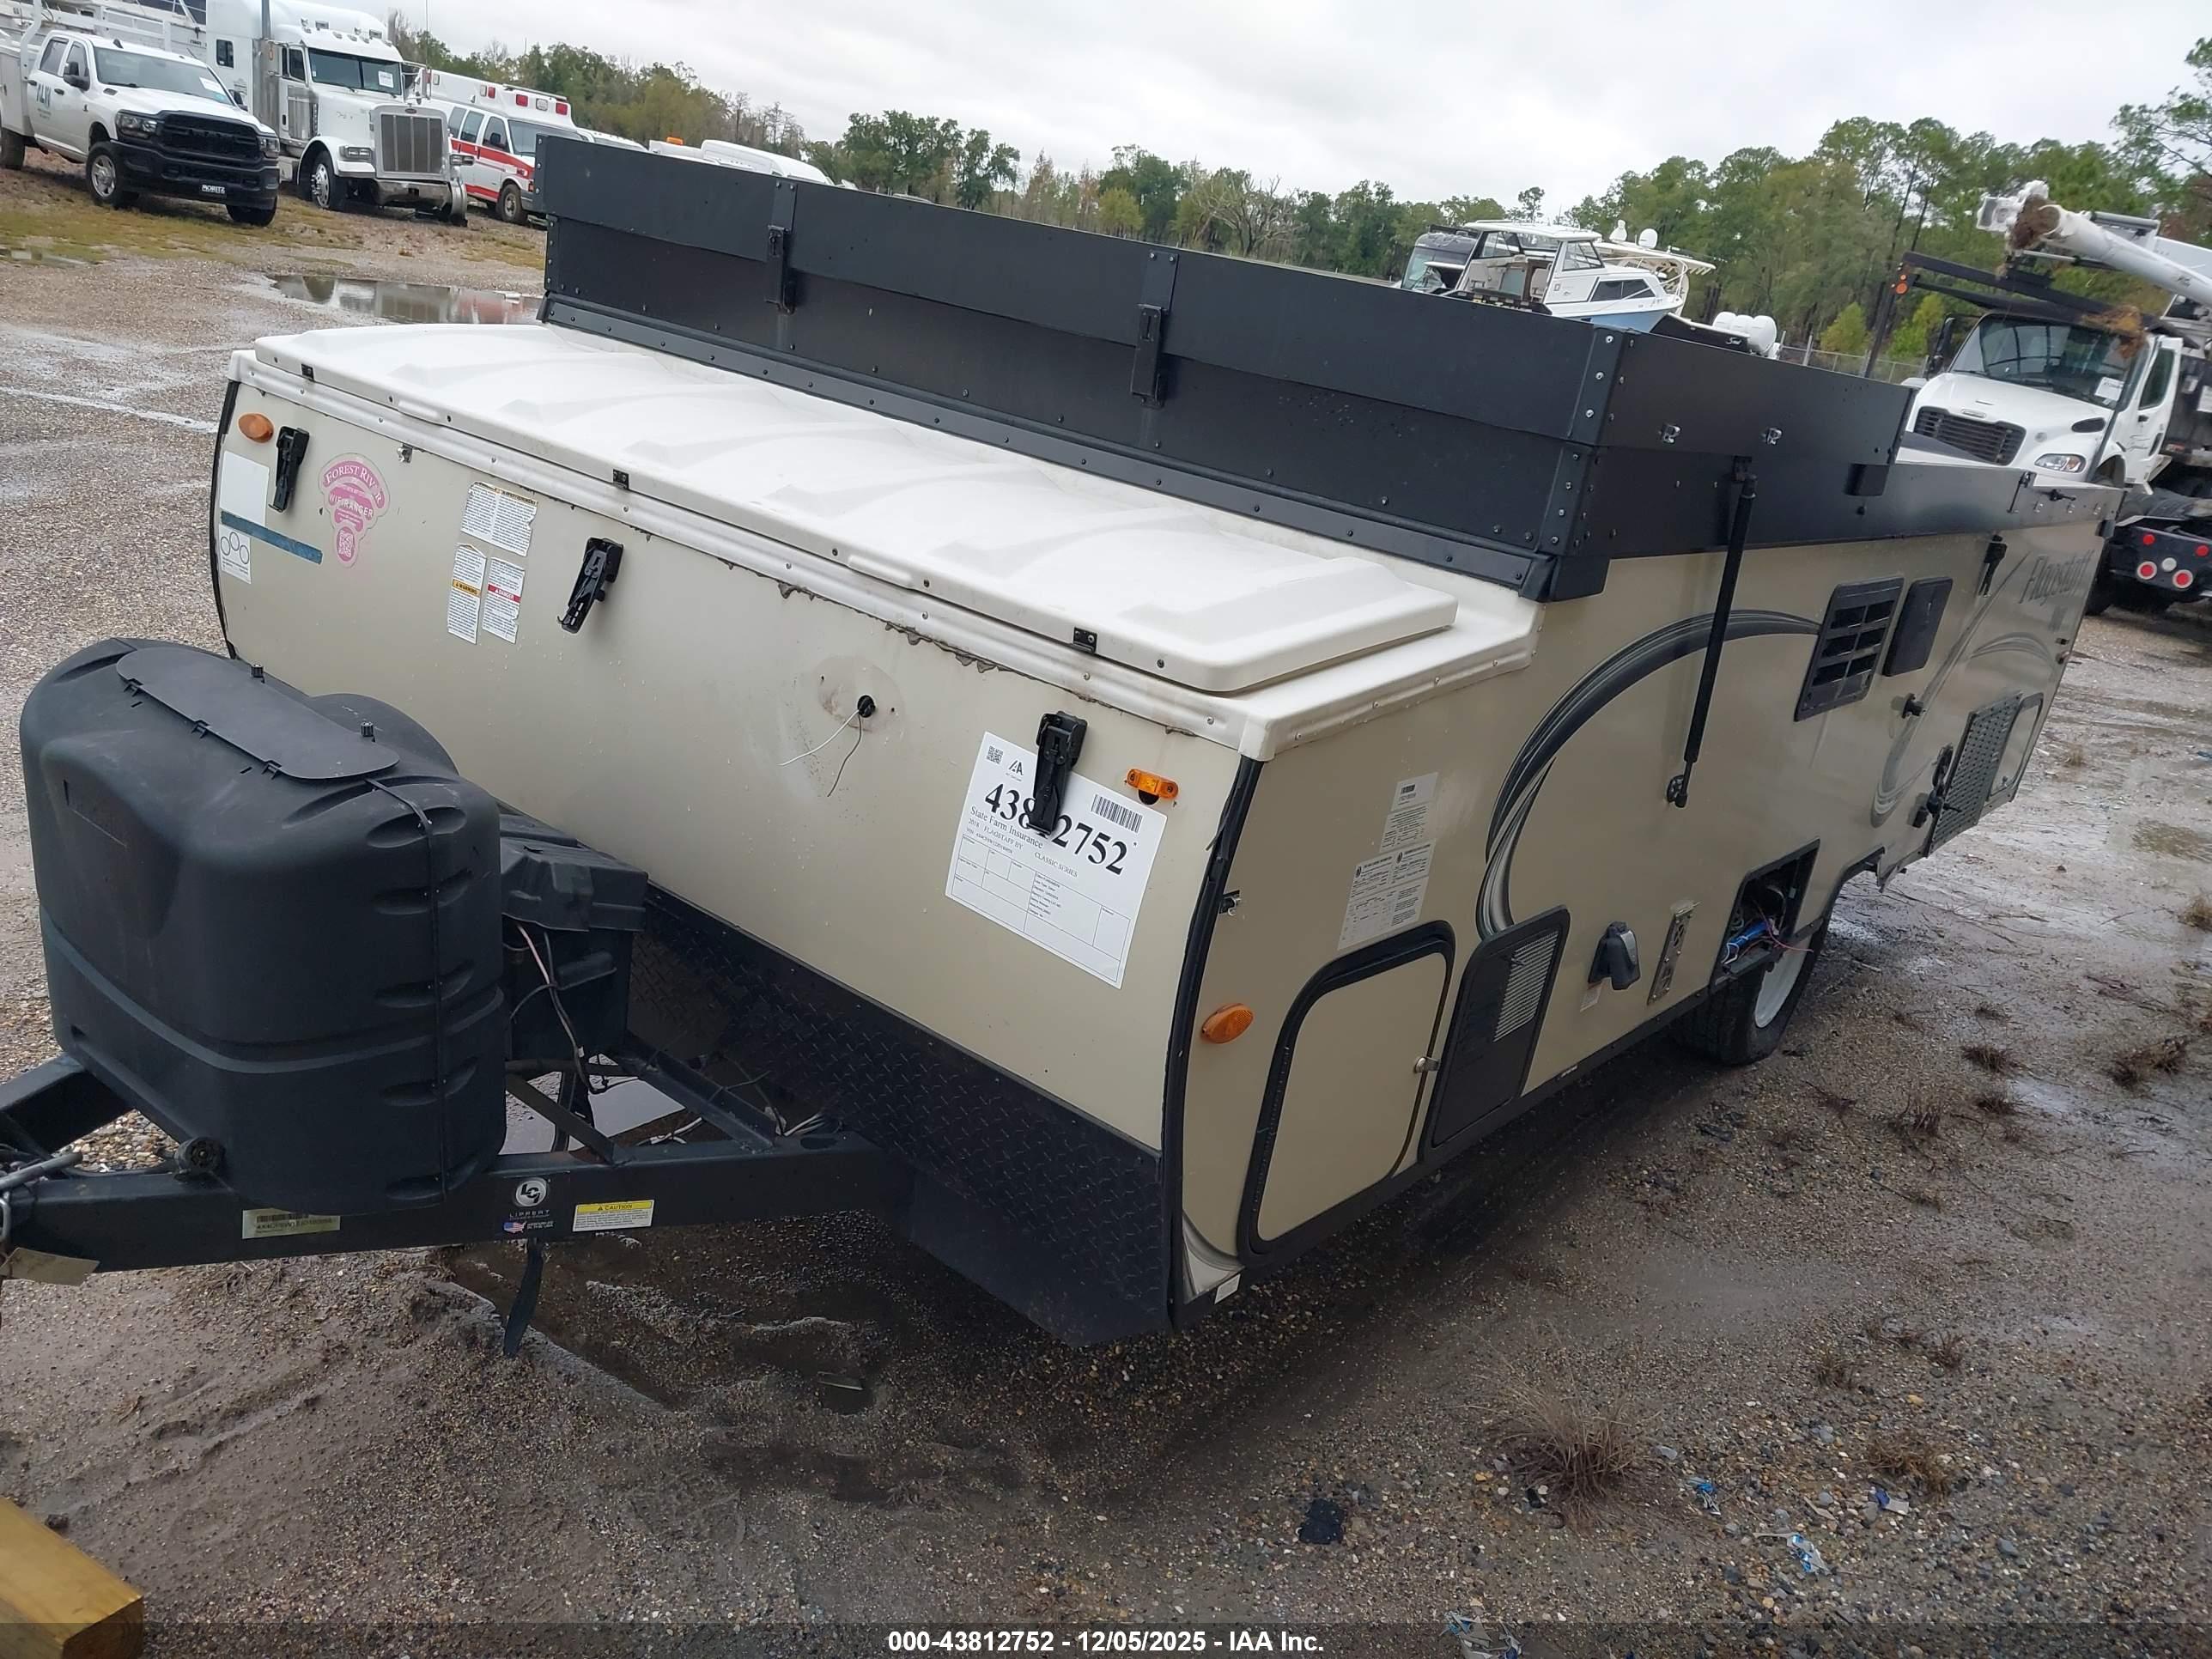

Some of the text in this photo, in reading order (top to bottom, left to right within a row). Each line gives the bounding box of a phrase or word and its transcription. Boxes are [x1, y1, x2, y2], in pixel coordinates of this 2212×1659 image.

[201, 184, 226, 195] MORITZ
[325, 465, 361, 485] FOREST
[359, 466, 383, 505] RIVR
[970, 805, 988, 822] State
[989, 815, 1008, 831] Farm
[1009, 824, 1044, 849] Insurance
[984, 782, 1127, 876] 4382752
[983, 825, 1014, 844] FLAGSTAFF
[1034, 852, 1059, 867] CLASSIC
[1059, 864, 1079, 878] SERIES
